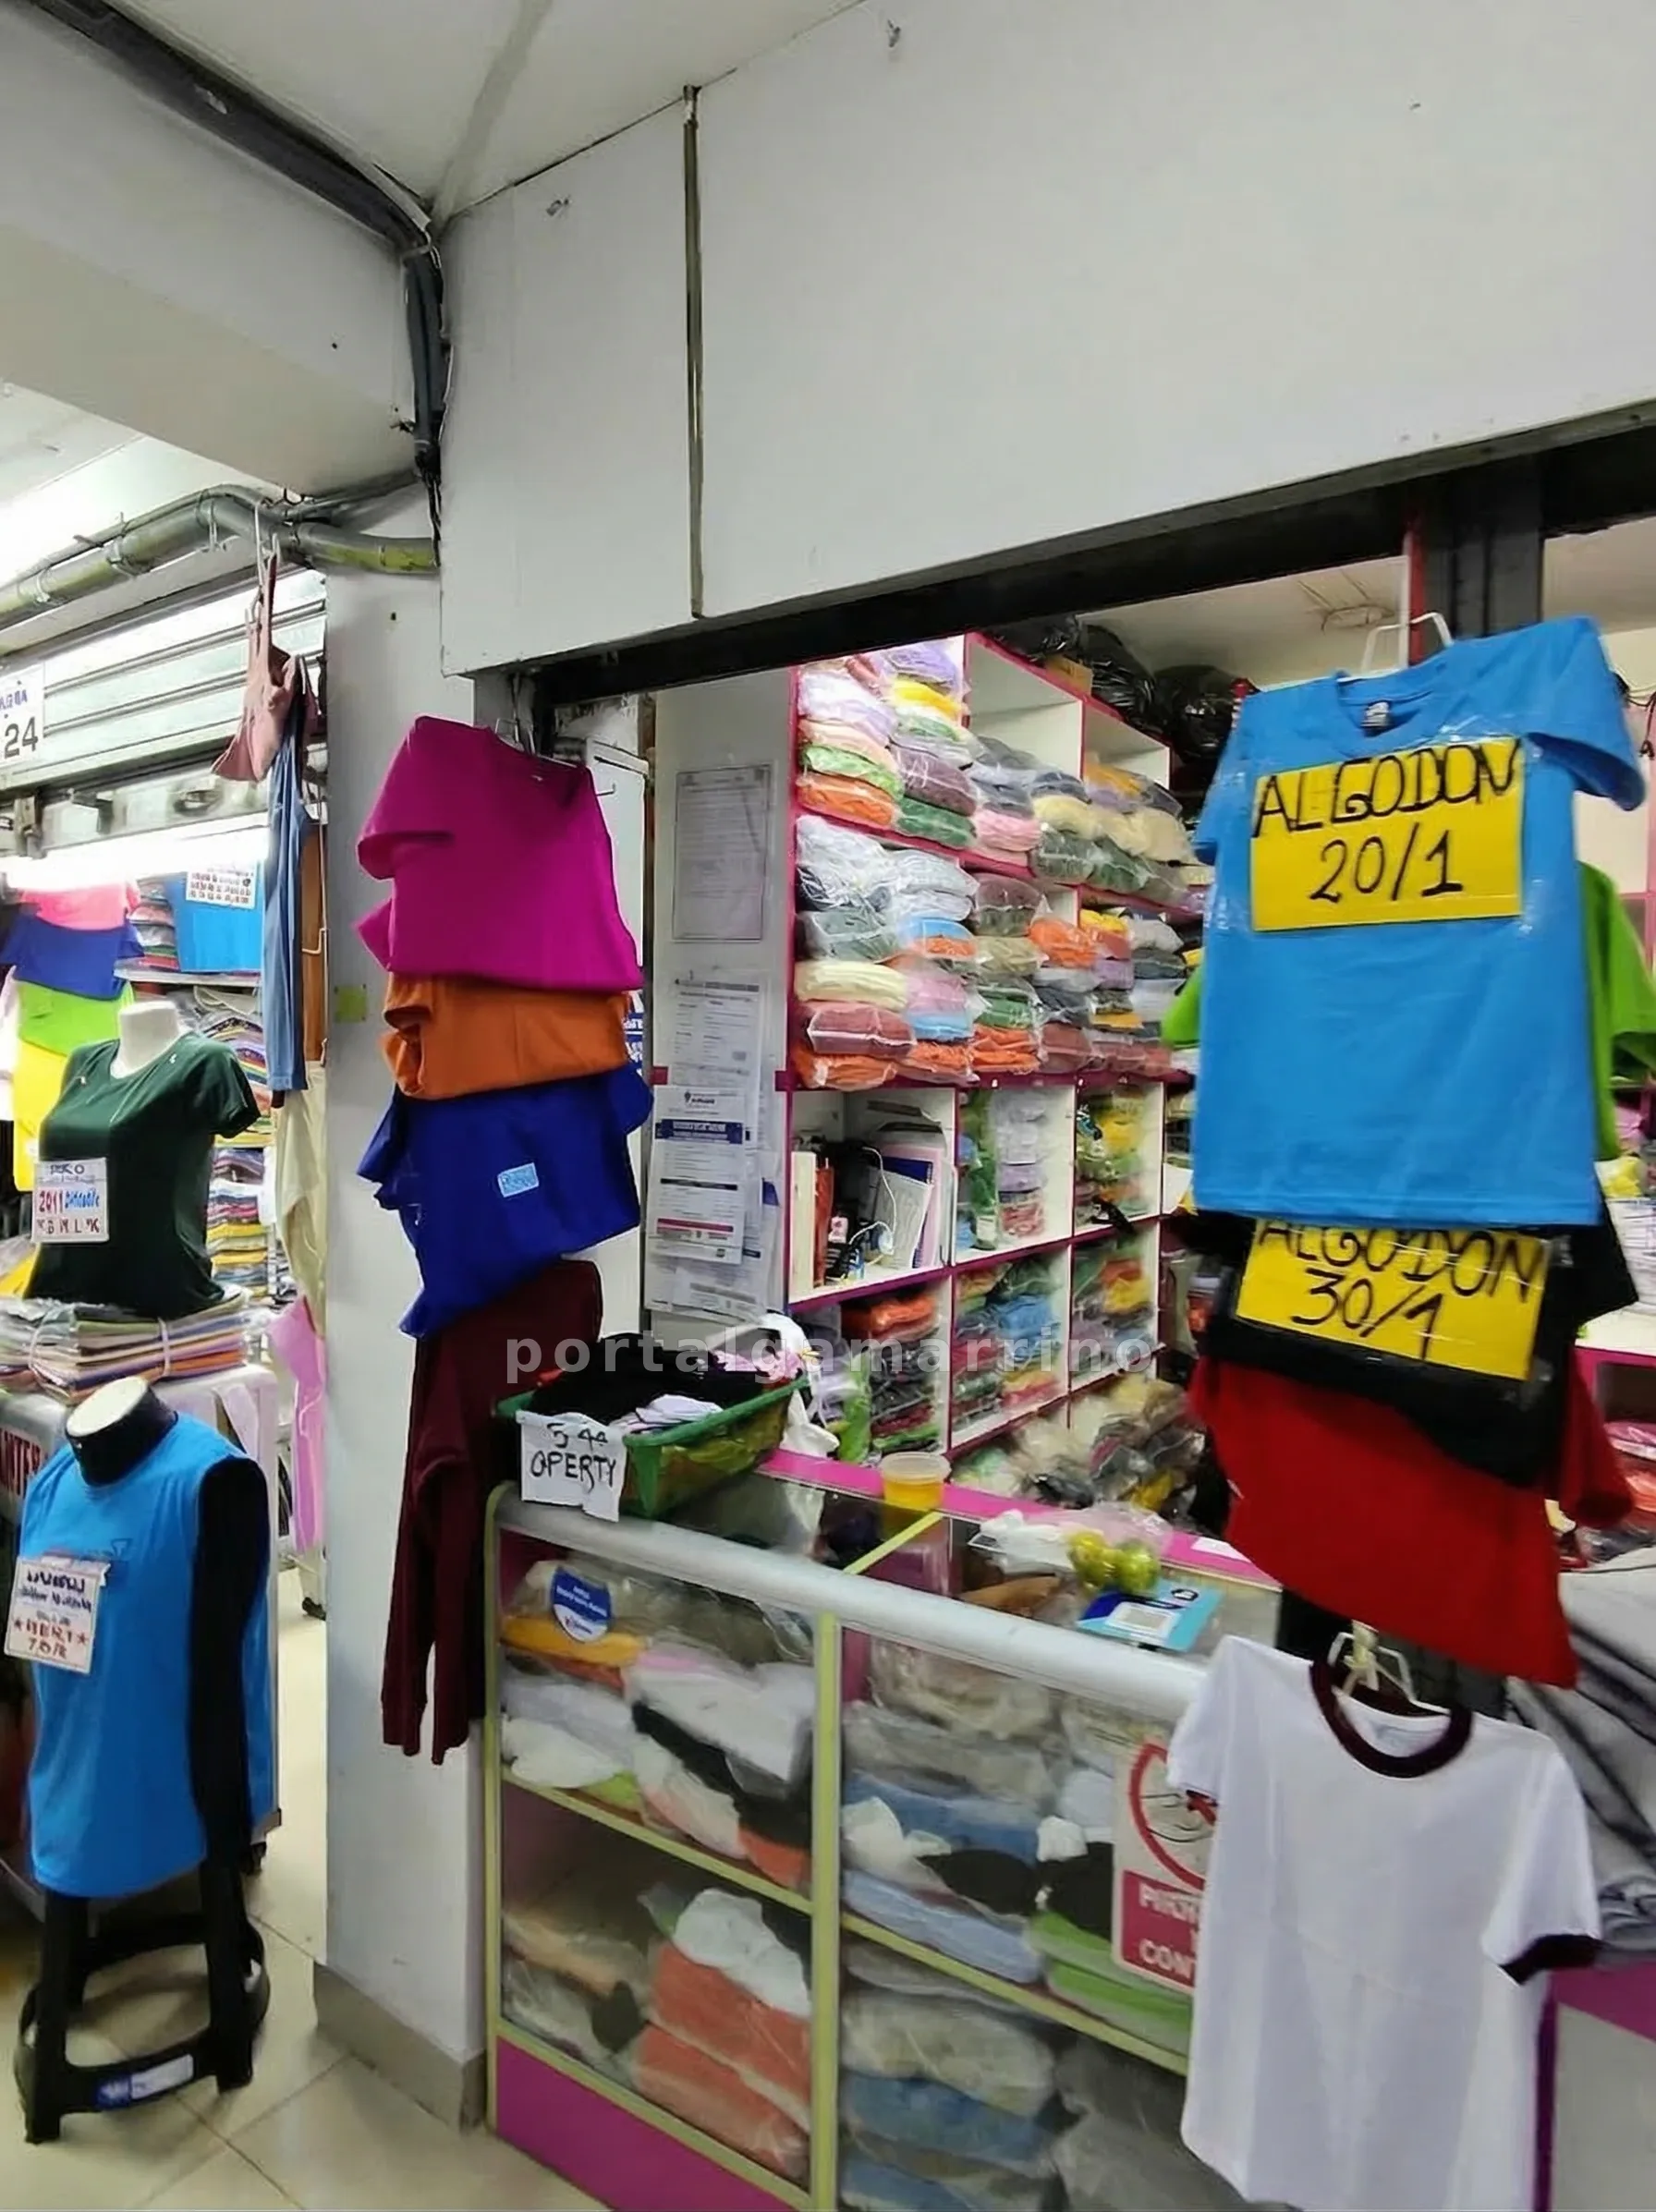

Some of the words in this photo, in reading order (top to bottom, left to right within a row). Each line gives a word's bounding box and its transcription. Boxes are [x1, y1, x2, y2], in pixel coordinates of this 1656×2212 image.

[4, 716, 39, 759] 24
[1251, 739, 1521, 838] ALGODON
[1309, 822, 1463, 904] 20/1
[1258, 1225, 1543, 1304] ALGODON
[1290, 1268, 1444, 1360] 30/1
